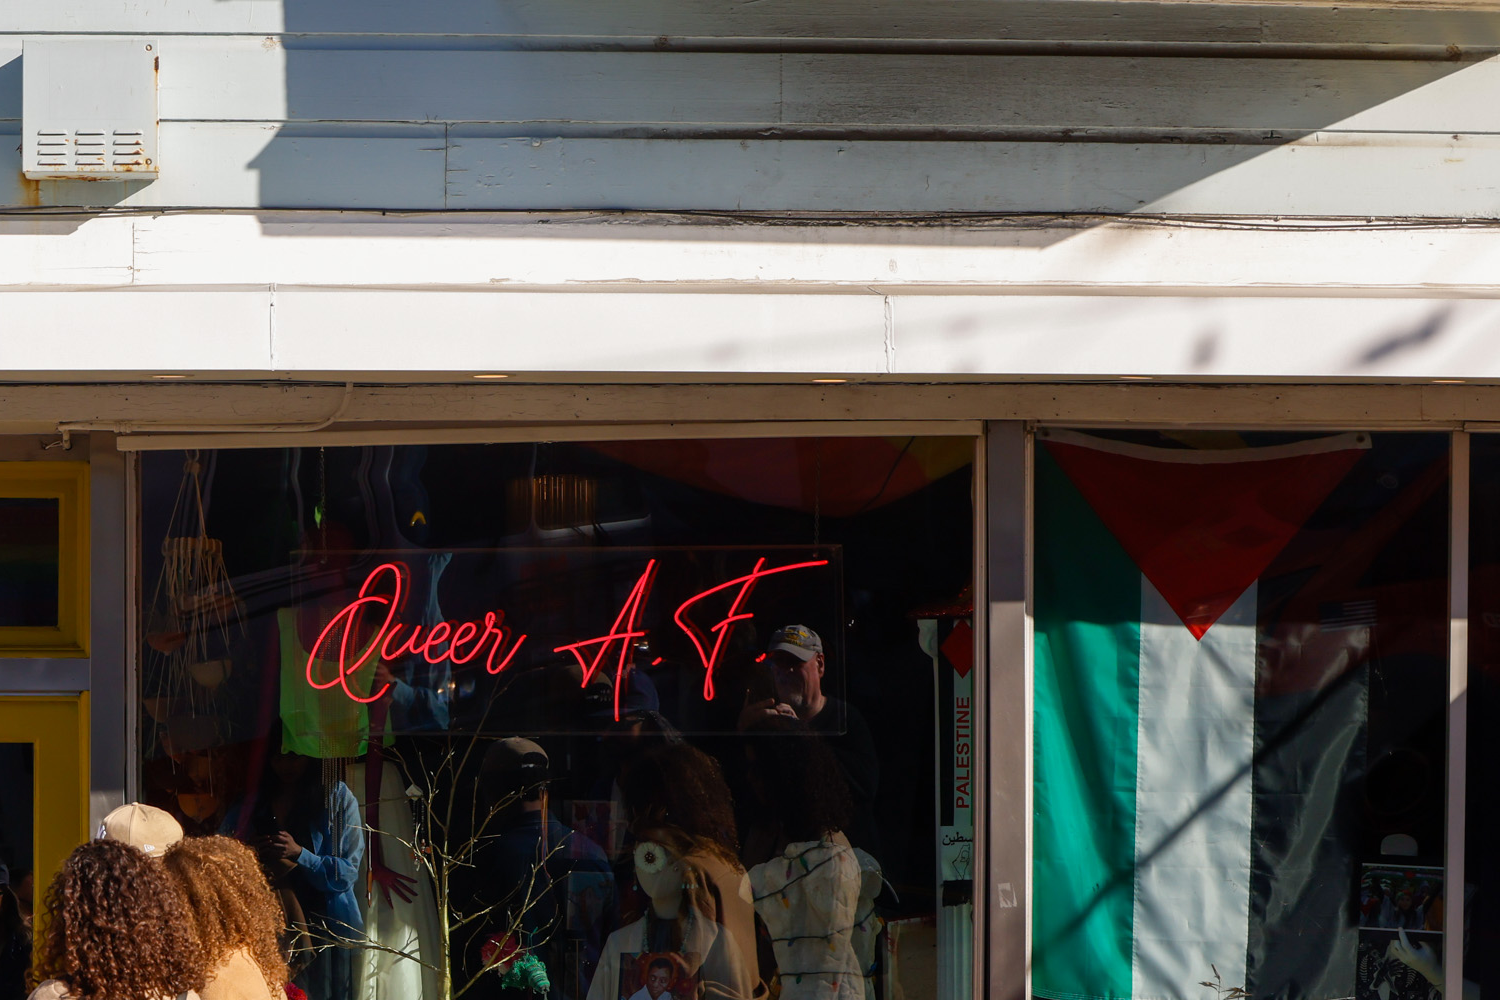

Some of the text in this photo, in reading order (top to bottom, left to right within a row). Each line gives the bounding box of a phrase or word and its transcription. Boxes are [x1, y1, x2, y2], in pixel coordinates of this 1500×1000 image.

[306, 563, 527, 704] Queer
[956, 696, 970, 809] PALESTINE
[942, 832, 973, 846] سطين
